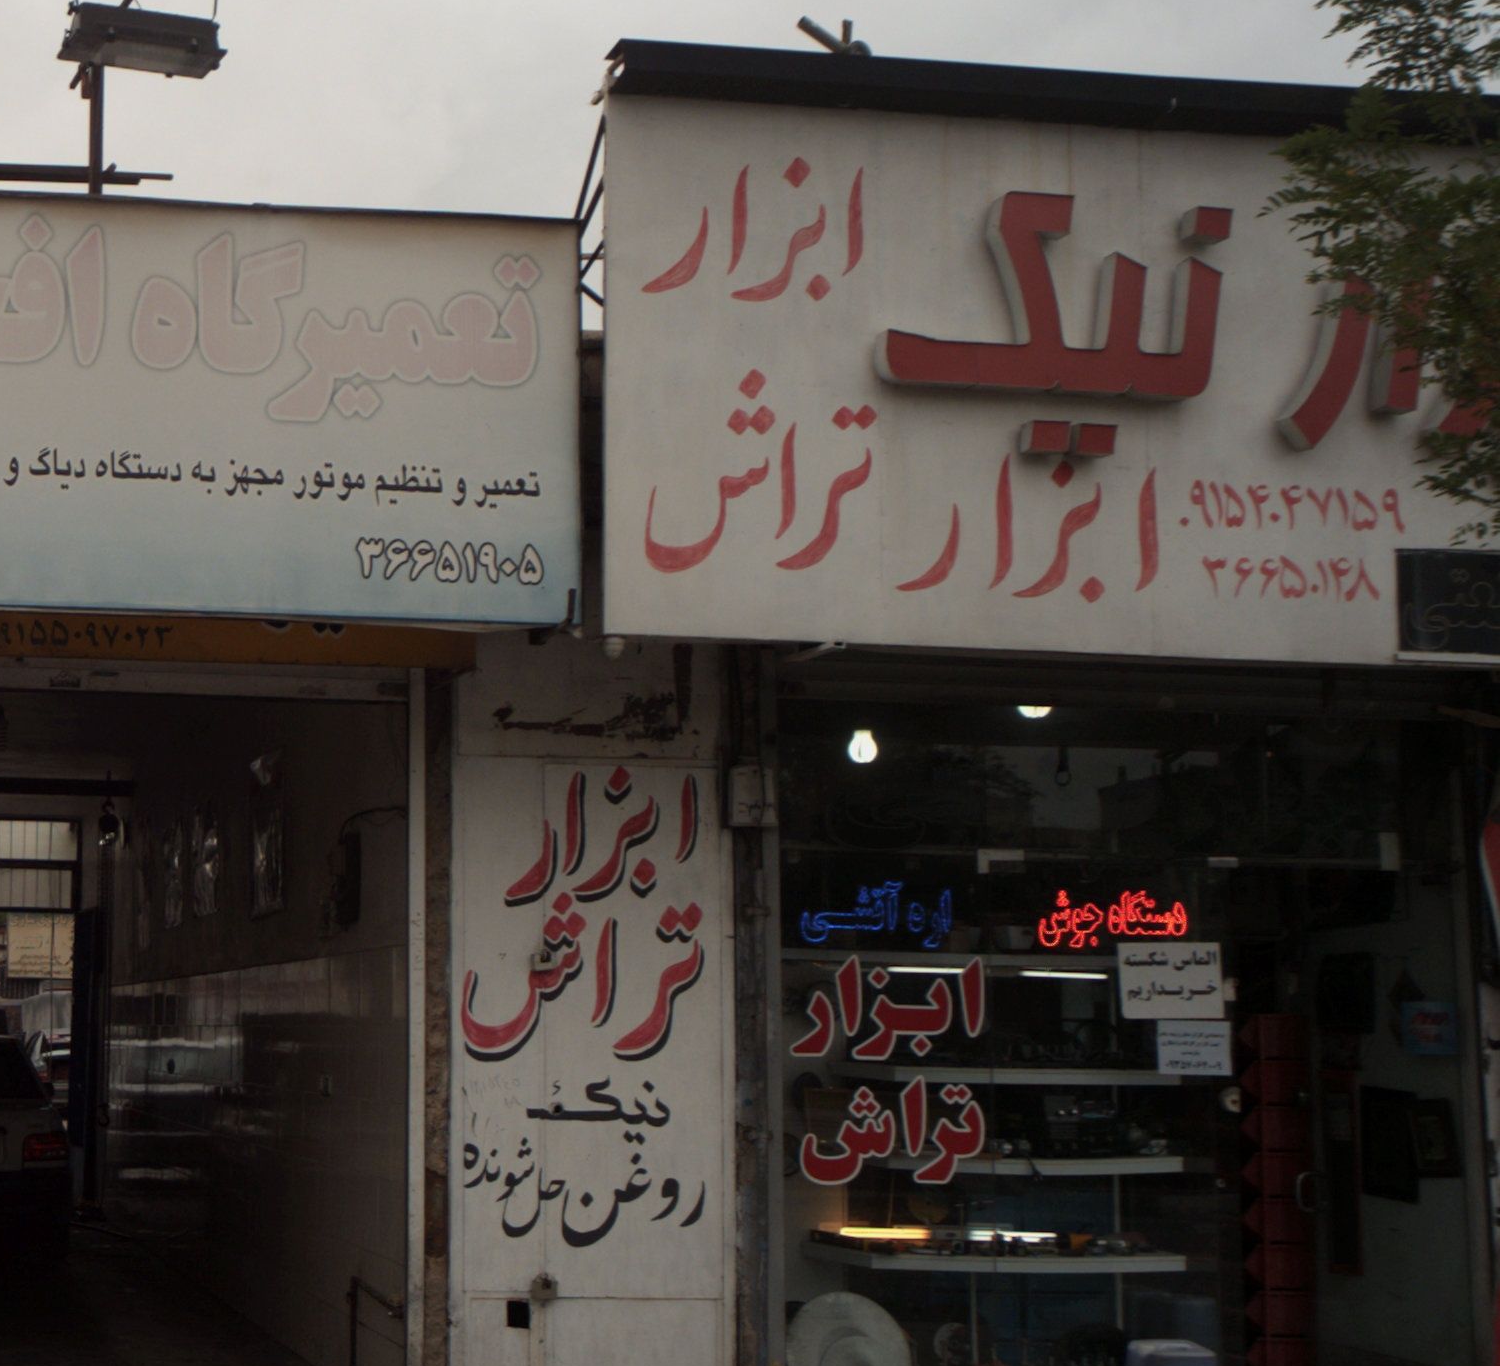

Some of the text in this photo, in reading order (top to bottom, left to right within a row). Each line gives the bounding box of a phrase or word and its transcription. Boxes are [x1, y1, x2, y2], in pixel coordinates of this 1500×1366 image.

[641, 155, 865, 302] ابزار
[131, 232, 539, 422] تعمیرگاه
[874, 191, 1234, 458] نیک
[3, 454, 19, 486] و
[28, 448, 86, 490] دیاگ
[94, 449, 182, 482] دستگاه
[191, 459, 216, 494] به
[224, 457, 286, 497] مجهز
[293, 463, 367, 501] موتور
[375, 466, 445, 504] تنظیم
[477, 469, 541, 503] تعمیر
[645, 368, 1158, 604] ابزار تراش
[452, 481, 468, 507] و
[1179, 479, 1405, 534] ۰۹۱۵۴۰۴۷۱۵۹
[356, 536, 545, 586] ۳۶۶۵۱۹۰۵
[1202, 555, 1380, 602] ۳۶۶۵۰۱۴۸
[503, 765, 699, 907] ابزار
[1037, 887, 1189, 949] دستگاه جوش
[461, 892, 706, 1062] تراش
[790, 954, 985, 1061] ابزار
[526, 1076, 671, 1144] نیک
[800, 1075, 985, 1186] تراش
[562, 1154, 707, 1247] روغن
